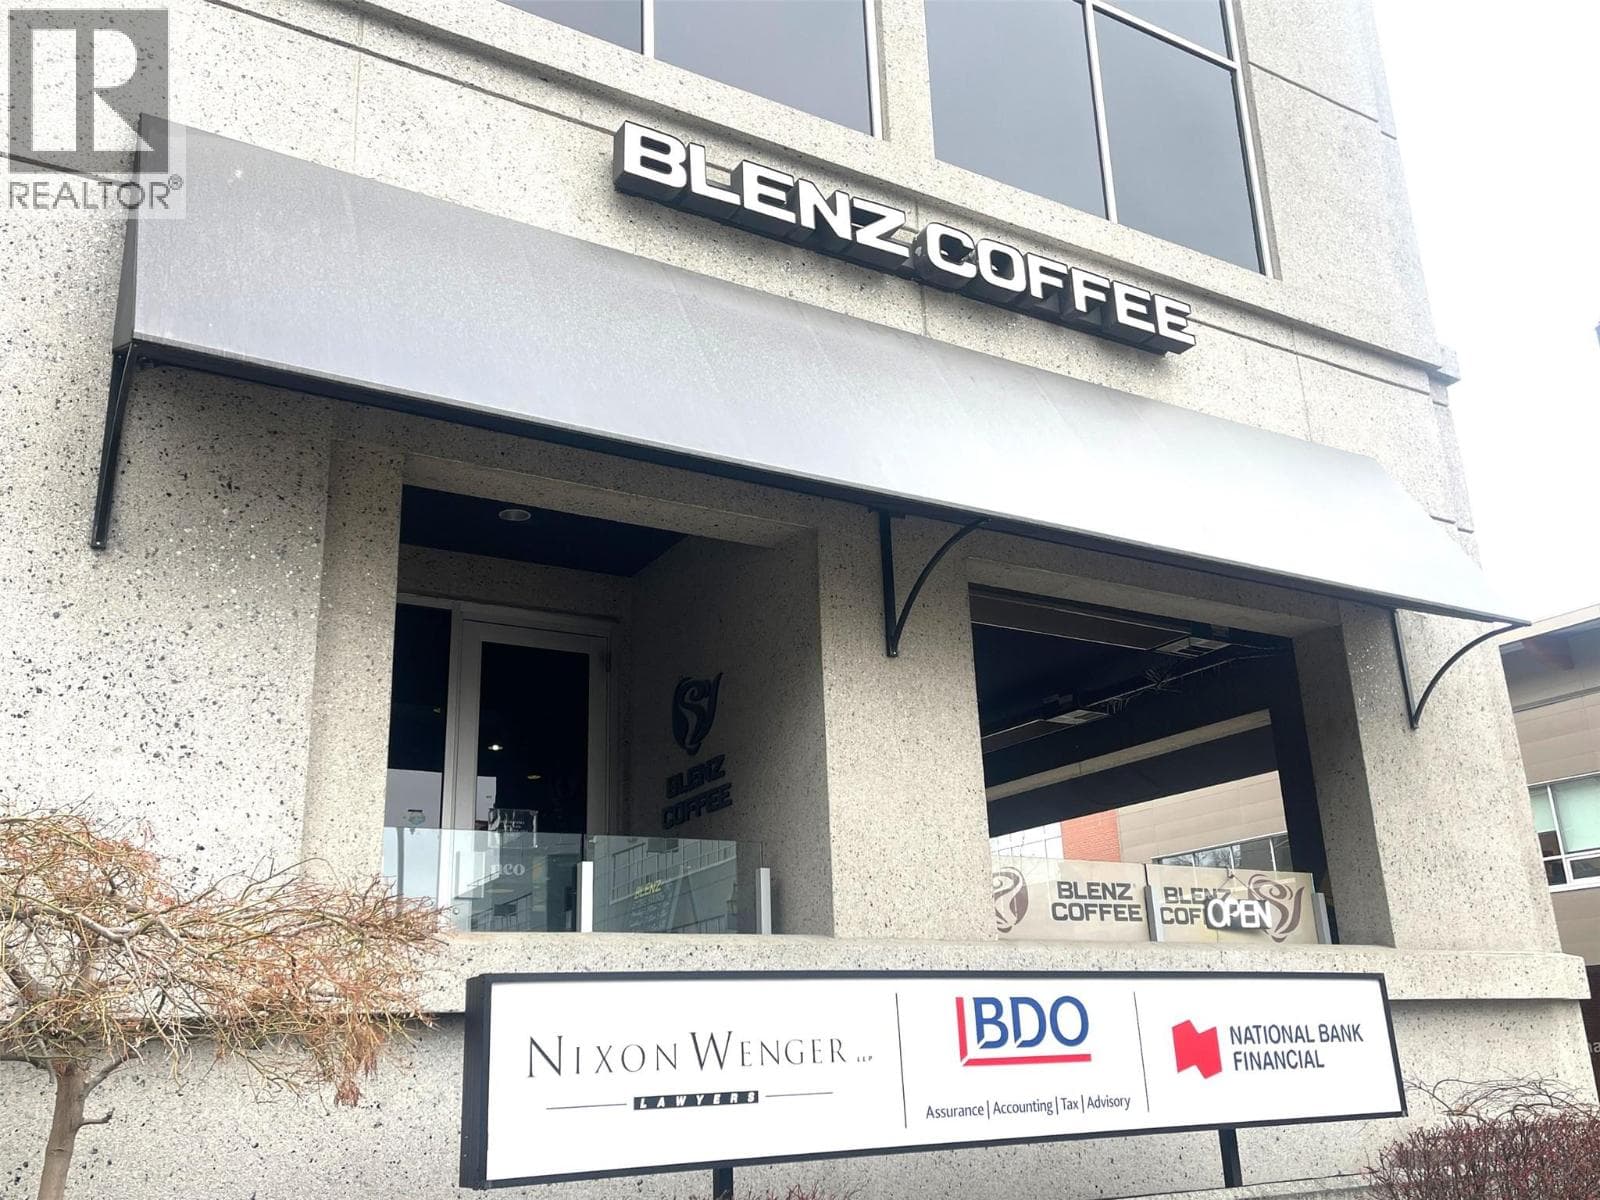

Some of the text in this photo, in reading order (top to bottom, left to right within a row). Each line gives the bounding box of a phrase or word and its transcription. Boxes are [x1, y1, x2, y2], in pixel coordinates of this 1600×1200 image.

[621, 121, 1196, 345] BLENZ COFFEE
[666, 753, 726, 799] BLENZ
[661, 782, 733, 831] COFFEE
[1057, 881, 1133, 901] BLENZ
[1163, 886, 1232, 904] BLENZ
[1051, 902, 1143, 922] COFFEE
[1160, 906, 1206, 925] COF
[1207, 898, 1273, 928] OPEN
[972, 995, 1090, 1049] BDO
[1229, 1023, 1364, 1045] NATIONAL BANK
[528, 1035, 679, 1078] NIXON
[690, 1030, 847, 1071] WENGER
[1233, 1049, 1325, 1071] FINANCIAL
[639, 1091, 756, 1109] LAWYERS
[926, 1094, 1131, 1119] Assurance Accounting Tax Advisory
